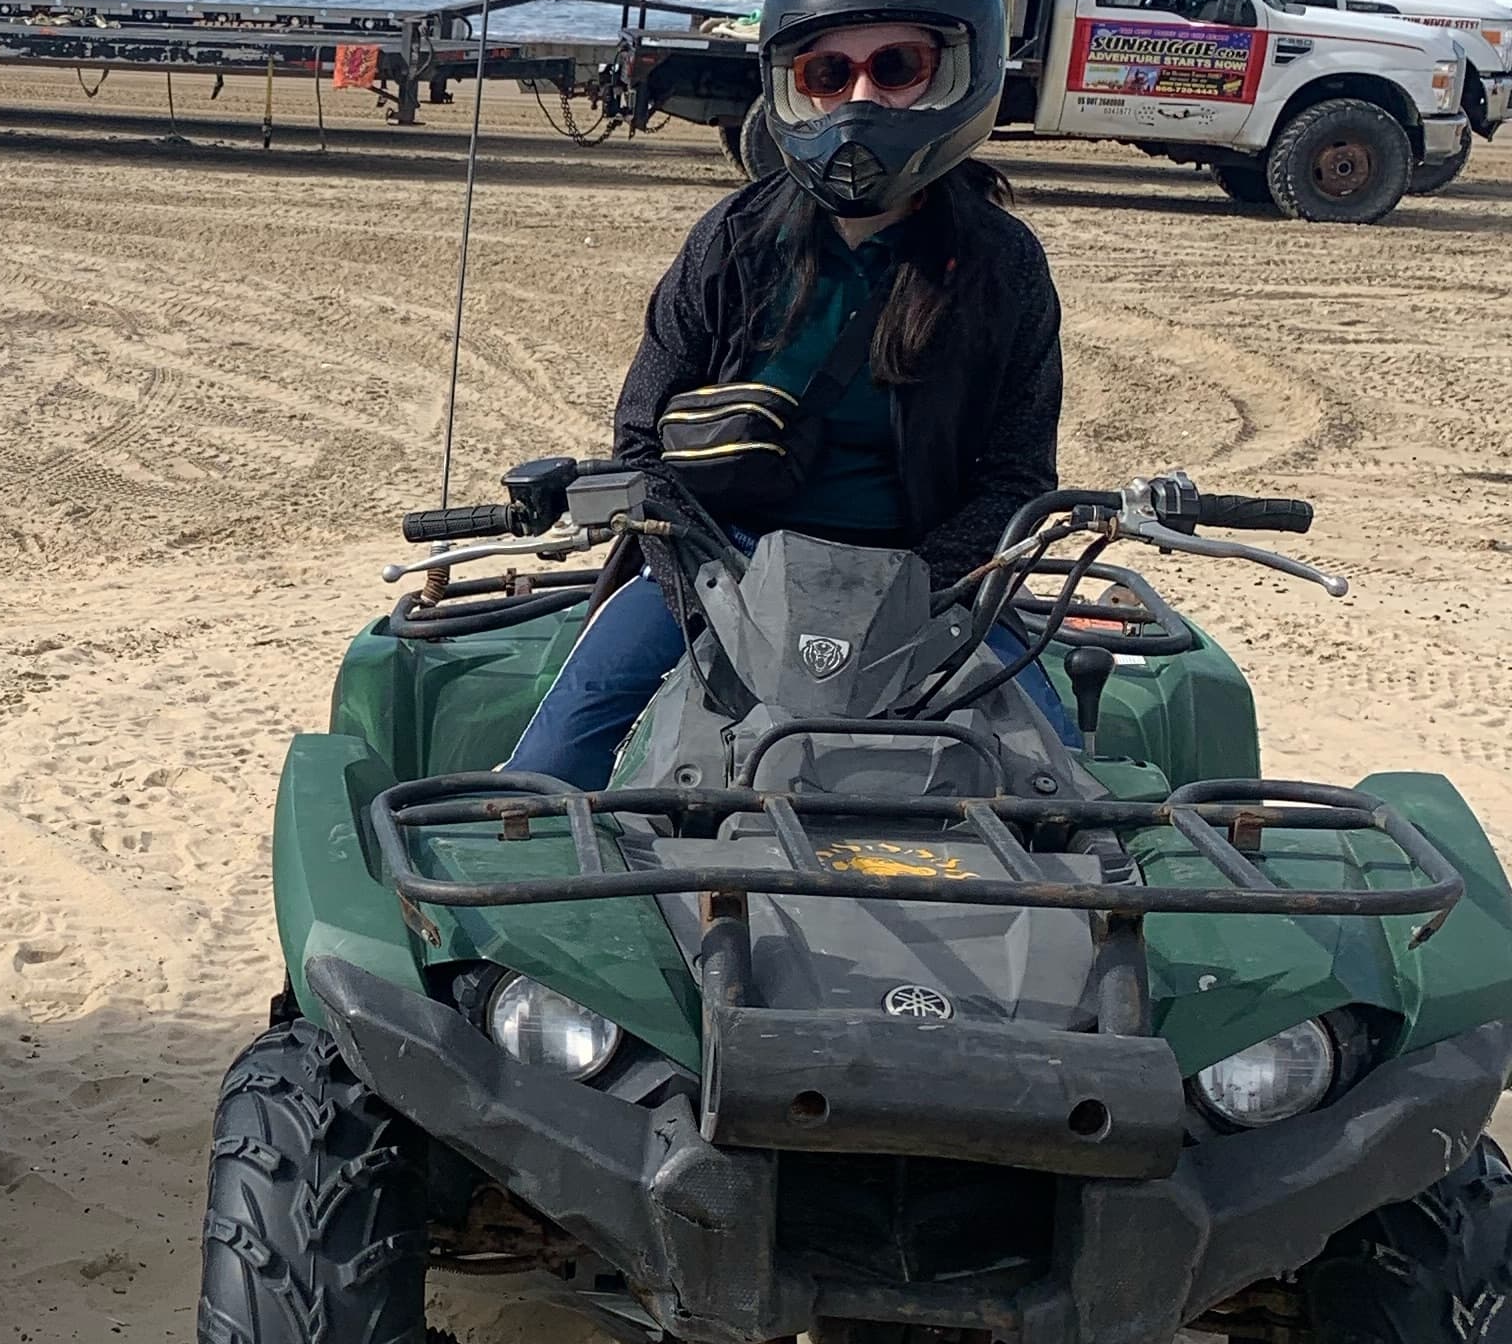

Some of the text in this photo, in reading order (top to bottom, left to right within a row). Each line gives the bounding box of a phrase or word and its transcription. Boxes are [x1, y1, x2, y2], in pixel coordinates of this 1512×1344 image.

[1088, 52, 1248, 72] ADVENTURE STARTS NOW!
